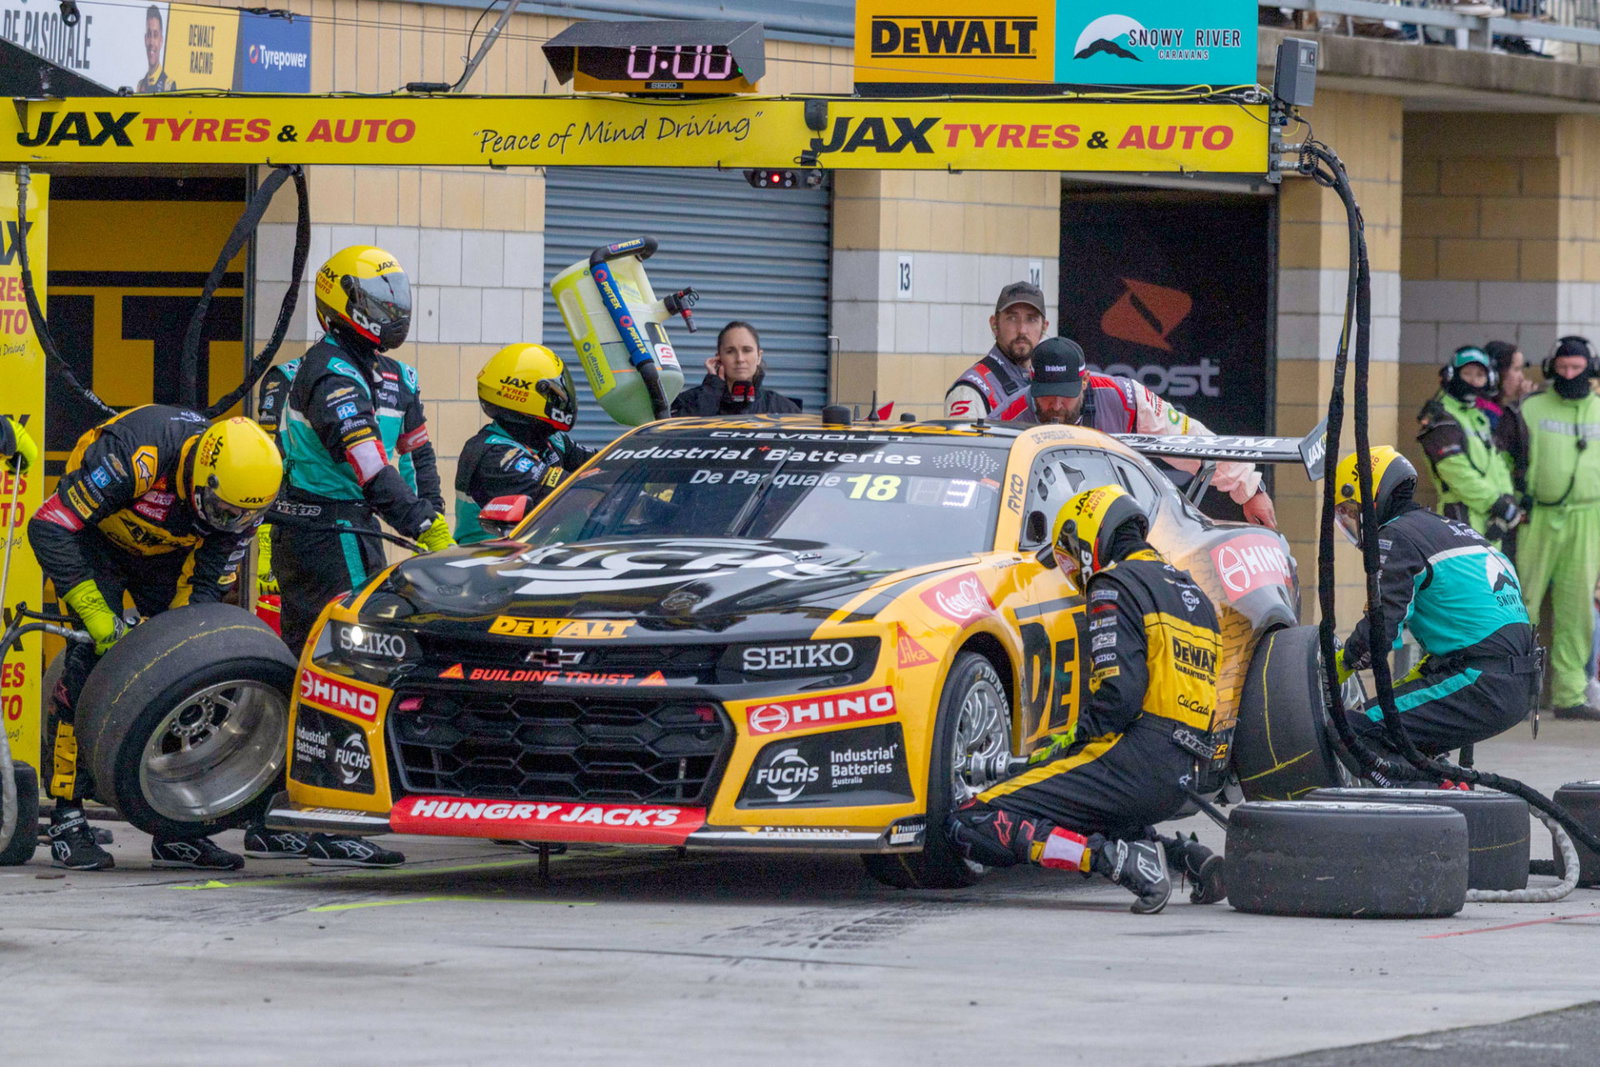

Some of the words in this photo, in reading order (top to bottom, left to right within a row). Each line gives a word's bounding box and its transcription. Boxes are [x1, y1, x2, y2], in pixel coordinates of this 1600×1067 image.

[188, 24, 215, 48] DEWALT
[871, 20, 1038, 55] DEWALT
[1128, 29, 1184, 47] SNOWY
[1195, 29, 1242, 48] RIVER
[189, 52, 214, 75] RACING
[259, 44, 308, 71] Tyrepower
[1158, 50, 1210, 60] CARAVANS
[650, 82, 678, 90] SEIKO
[16, 111, 141, 147] JAX
[142, 118, 272, 143] TYRES
[276, 125, 299, 143] &
[305, 119, 417, 144] AUTO
[547, 123, 576, 155] of
[578, 117, 649, 145] Mind
[815, 116, 942, 153] JAX
[943, 124, 1081, 149] TYRES
[1086, 131, 1109, 150] &
[1116, 125, 1235, 151] AUTO
[320, 265, 339, 283] JAX
[376, 260, 395, 273] JAX
[899, 262, 911, 291] 13
[1028, 267, 1041, 287] 14
[601, 281, 622, 310] PIRTEK
[626, 326, 648, 355] PIRTEK
[500, 376, 533, 390] JAX
[500, 385, 530, 397] TYRES
[503, 393, 527, 403] AUTO
[709, 430, 914, 443] CHEVROLET
[606, 446, 760, 463] Industrial
[689, 469, 713, 485] De
[846, 473, 901, 502] 18
[1007, 473, 1024, 515] RYCO
[239, 496, 265, 504] JAX
[1496, 594, 1520, 608] SNOW
[490, 617, 637, 639] DEWALT
[340, 626, 406, 658] SIKO
[743, 642, 855, 672] SEIKO
[470, 667, 560, 682] BUILDING
[562, 672, 635, 686] TRUST
[314, 684, 377, 716] HINO
[792, 691, 894, 723] HINO
[334, 748, 371, 770] FUCHS
[755, 766, 820, 785] FUCHS
[831, 762, 893, 778] Batteries
[832, 776, 863, 788] Australia
[409, 799, 564, 820] HUNGRY
[765, 826, 851, 834] PENINSULA
